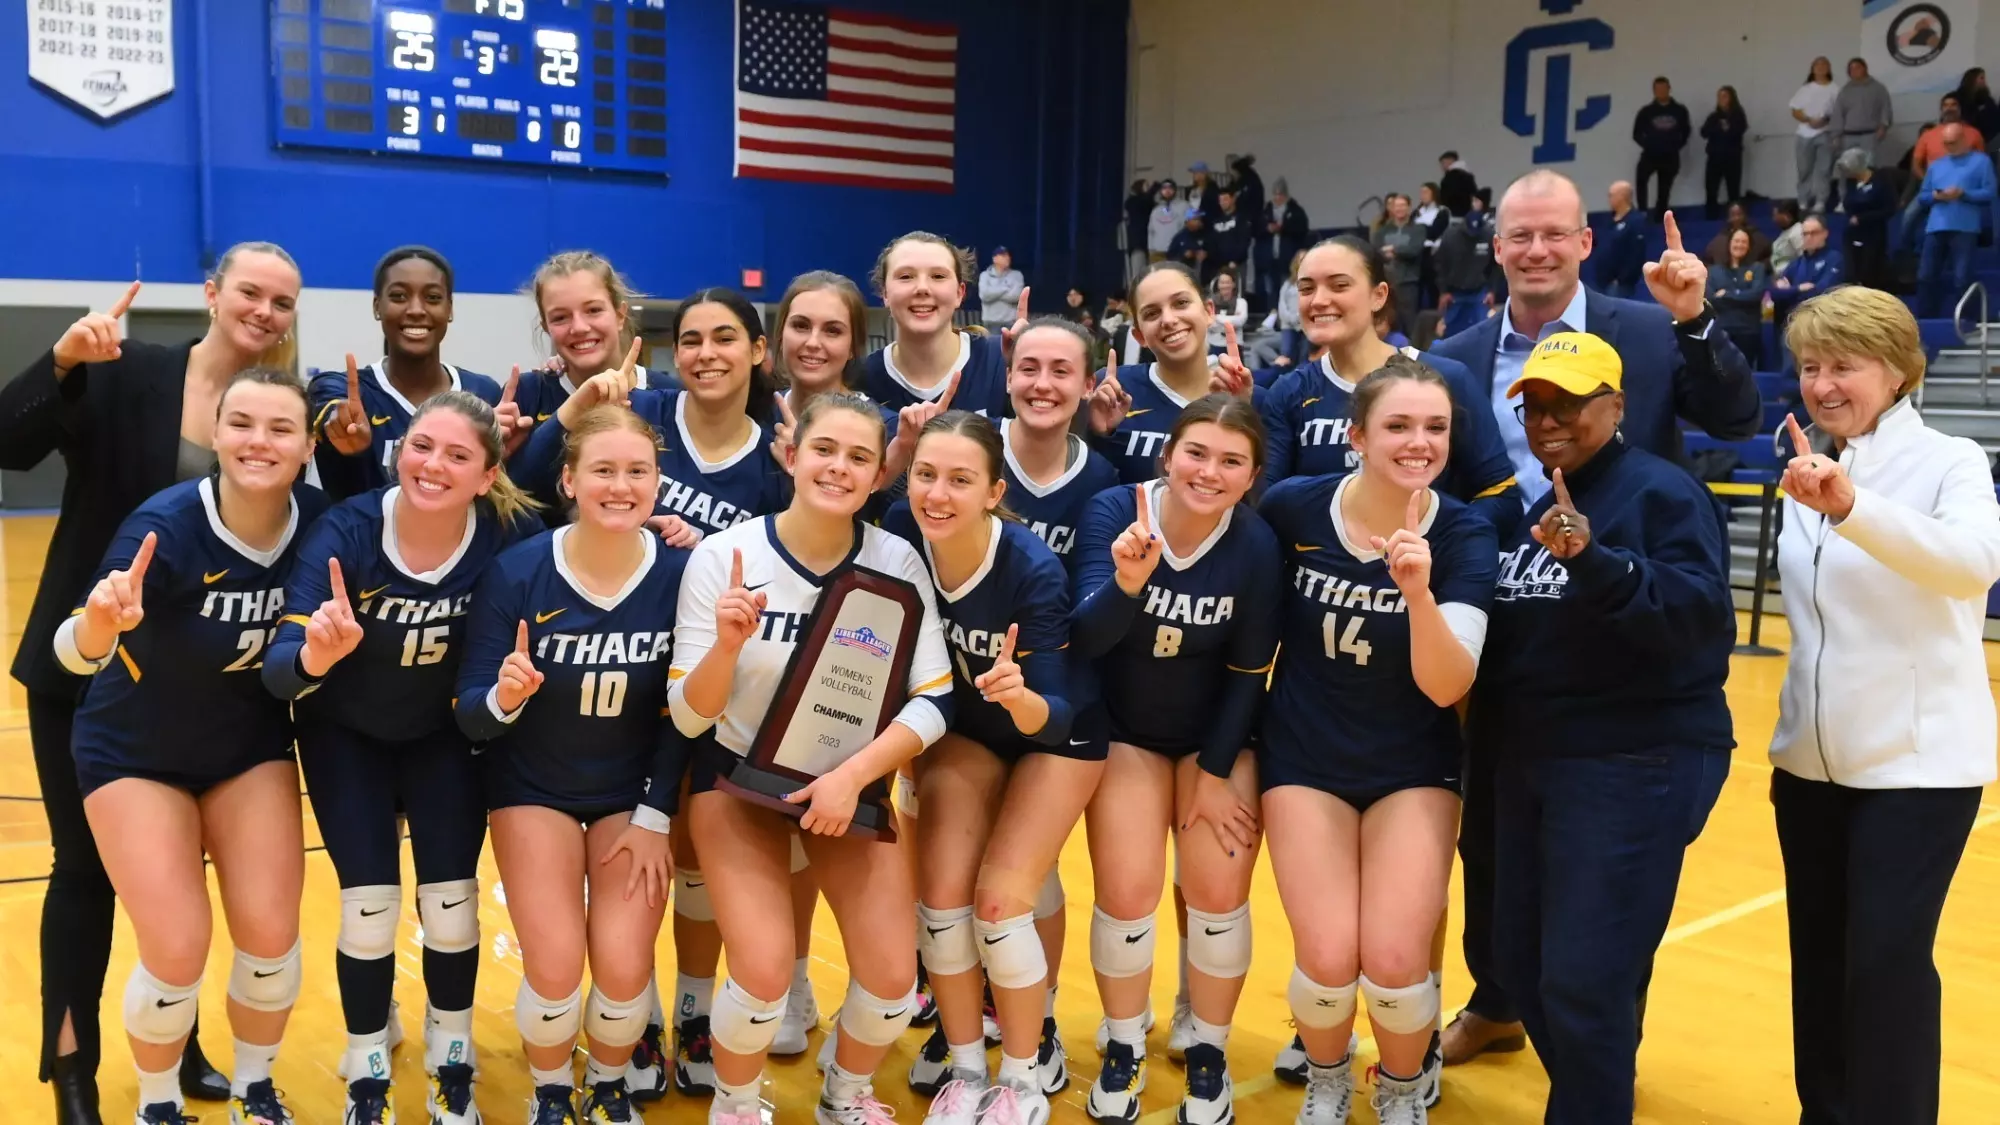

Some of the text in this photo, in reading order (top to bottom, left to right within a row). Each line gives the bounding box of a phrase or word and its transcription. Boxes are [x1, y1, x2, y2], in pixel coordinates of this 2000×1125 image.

[393, 31, 434, 71] 25
[478, 46, 494, 74] 3
[540, 49, 579, 87] 22
[402, 106, 419, 135] 3
[564, 121, 580, 148] 0
[1144, 585, 1235, 625] HACA
[400, 625, 450, 667] 15
[536, 631, 672, 664] ITHACA
[1153, 624, 1183, 658] 8
[1322, 611, 1372, 666] 14
[821, 676, 873, 701] VOLLEYBALL
[830, 664, 873, 686] WOMEN'S
[580, 671, 628, 718] 10
[813, 703, 863, 727] CHAMPION
[817, 734, 841, 749] 2023
